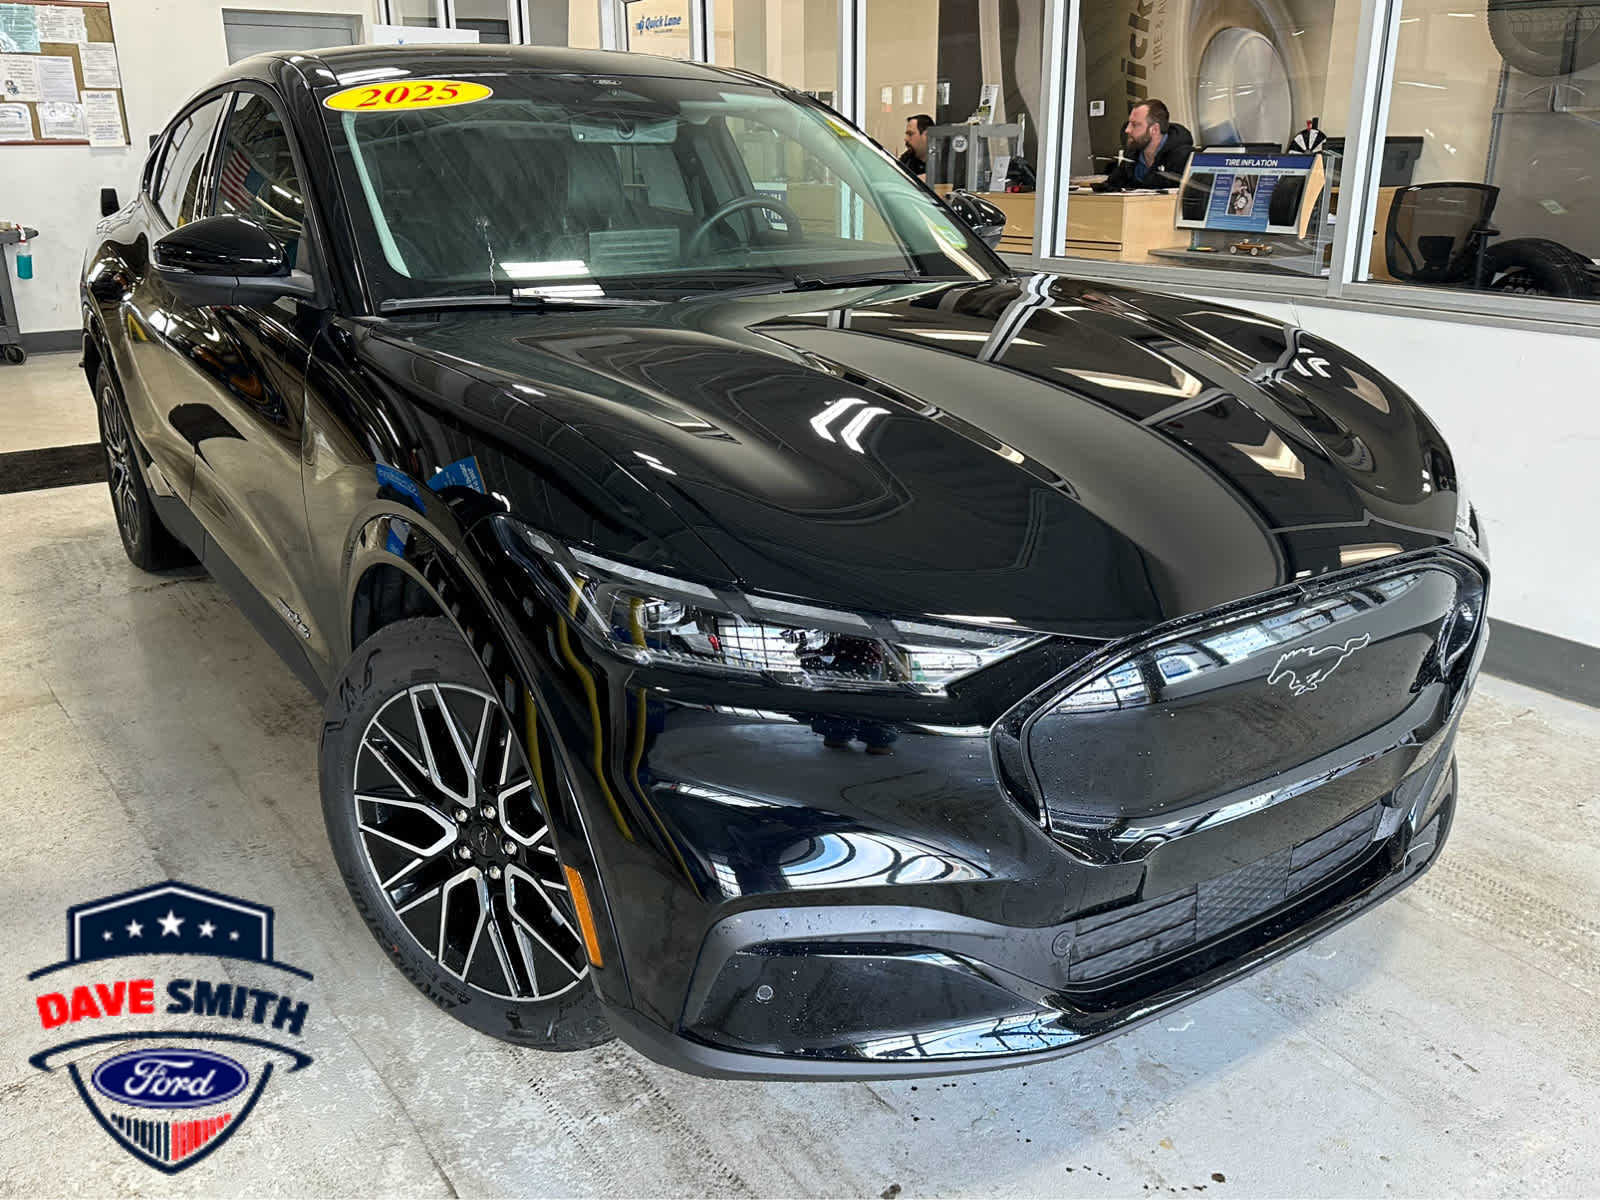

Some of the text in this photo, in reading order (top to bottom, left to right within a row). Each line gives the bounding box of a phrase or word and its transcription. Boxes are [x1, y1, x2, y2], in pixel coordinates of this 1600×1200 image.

[645, 15, 681, 30] Quick Lane
[356, 84, 461, 108] 2025
[1225, 158, 1279, 168] TIRE INFLATION
